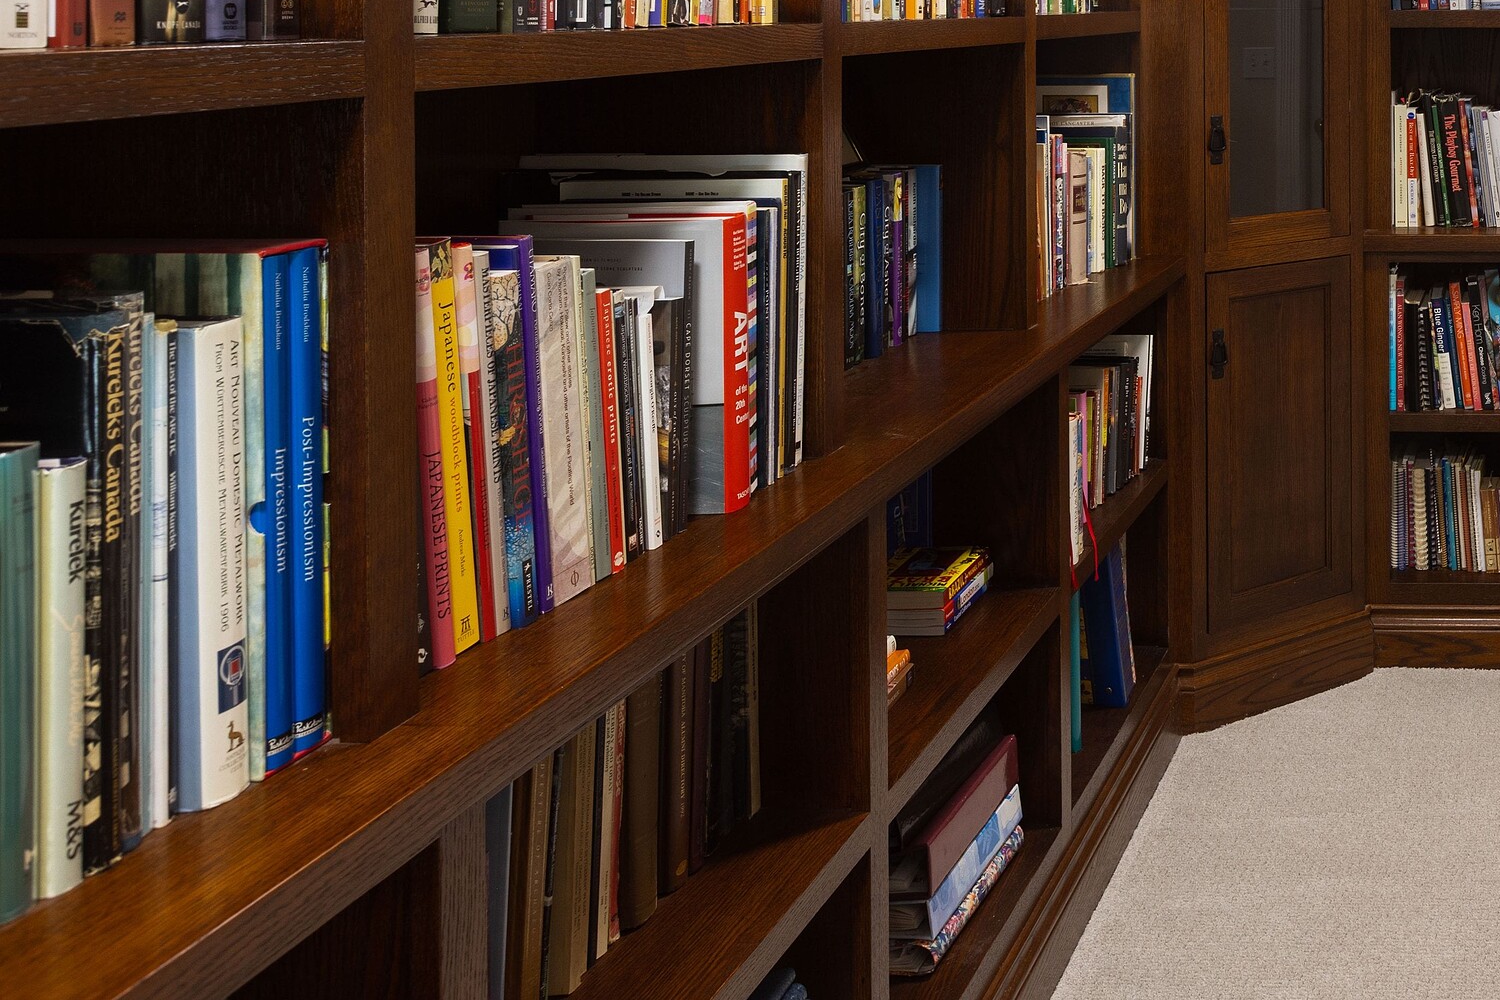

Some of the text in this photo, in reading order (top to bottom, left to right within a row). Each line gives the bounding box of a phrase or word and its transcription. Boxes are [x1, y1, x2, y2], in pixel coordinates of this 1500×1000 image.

[1444, 113, 1463, 193] The Playboy Gourmet
[856, 212, 867, 250] City
[859, 270, 867, 327] Bones
[1434, 307, 1446, 353] Blue Ginger
[1450, 290, 1466, 339] SIMPLY MING
[215, 342, 226, 373] FROM
[480, 265, 503, 484] MASTERPIECES OF JAPANESE PRINTS
[602, 301, 618, 444] Japanese erotic prints
[733, 310, 749, 372] ART
[436, 301, 465, 514] Japanese woodblock prints
[105, 444, 124, 543] Canada
[229, 338, 245, 625] ART NOUVEAU DOMESTIC METALWORK
[271, 448, 289, 574] Impressionism
[298, 416, 317, 583] Post-Impressionism
[68, 499, 86, 586] Kurelek
[219, 489, 230, 598] METALLWARENFABRIK
[423, 450, 452, 620] JAPANESE PRINTS
[219, 601, 230, 633] 1906
[525, 571, 534, 613] PRESTEL
[66, 799, 84, 861] M&S
